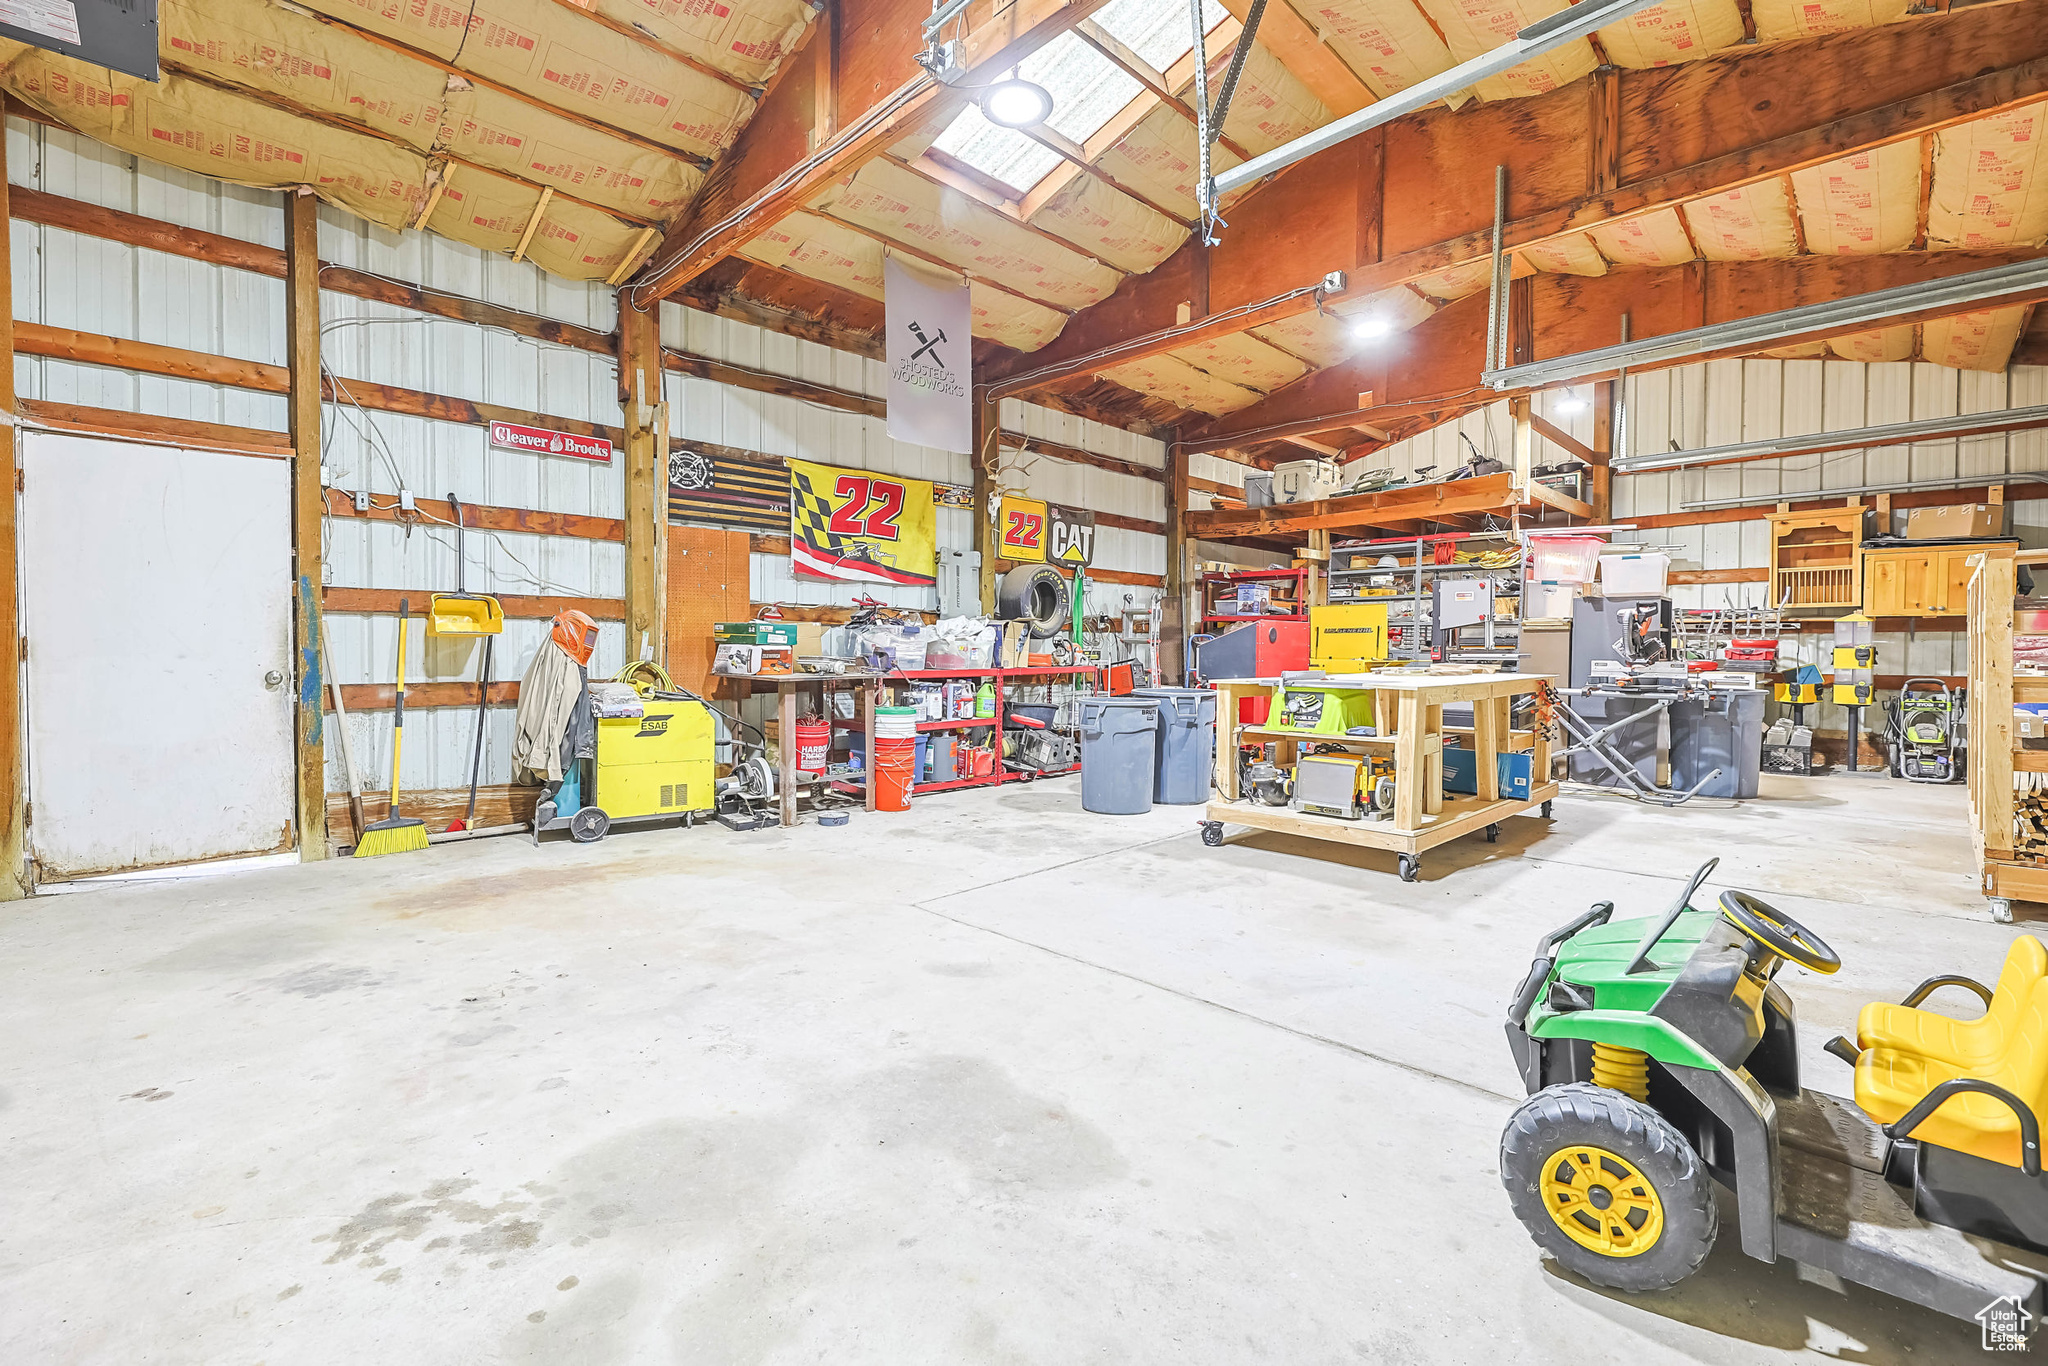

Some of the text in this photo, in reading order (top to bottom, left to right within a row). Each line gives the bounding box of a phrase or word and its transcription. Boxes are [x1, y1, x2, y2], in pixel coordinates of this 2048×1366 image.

[450, 10, 463, 28] PINK
[1491, 11, 1515, 24] R19
[1636, 17, 1662, 28] R19
[505, 30, 518, 48] PINK
[1360, 29, 1380, 40] R19
[52, 71, 69, 95] R19
[559, 73, 573, 88] PINK
[1528, 73, 1551, 85] R19
[98, 89, 111, 107] PINK
[587, 82, 604, 100] R19
[424, 106, 440, 124] R19
[235, 134, 251, 154] R19
[571, 171, 585, 185] R19
[850, 198, 864, 211] R19
[900, 358, 956, 384] SHOSTED'S
[891, 366, 965, 398] WOODWORKS
[494, 426, 609, 458] Cleaver Brooks
[769, 504, 783, 513] 261
[828, 475, 906, 542] 22
[1003, 510, 1044, 549] 22
[1051, 520, 1093, 563] CAT
[641, 721, 668, 731] ESAB
